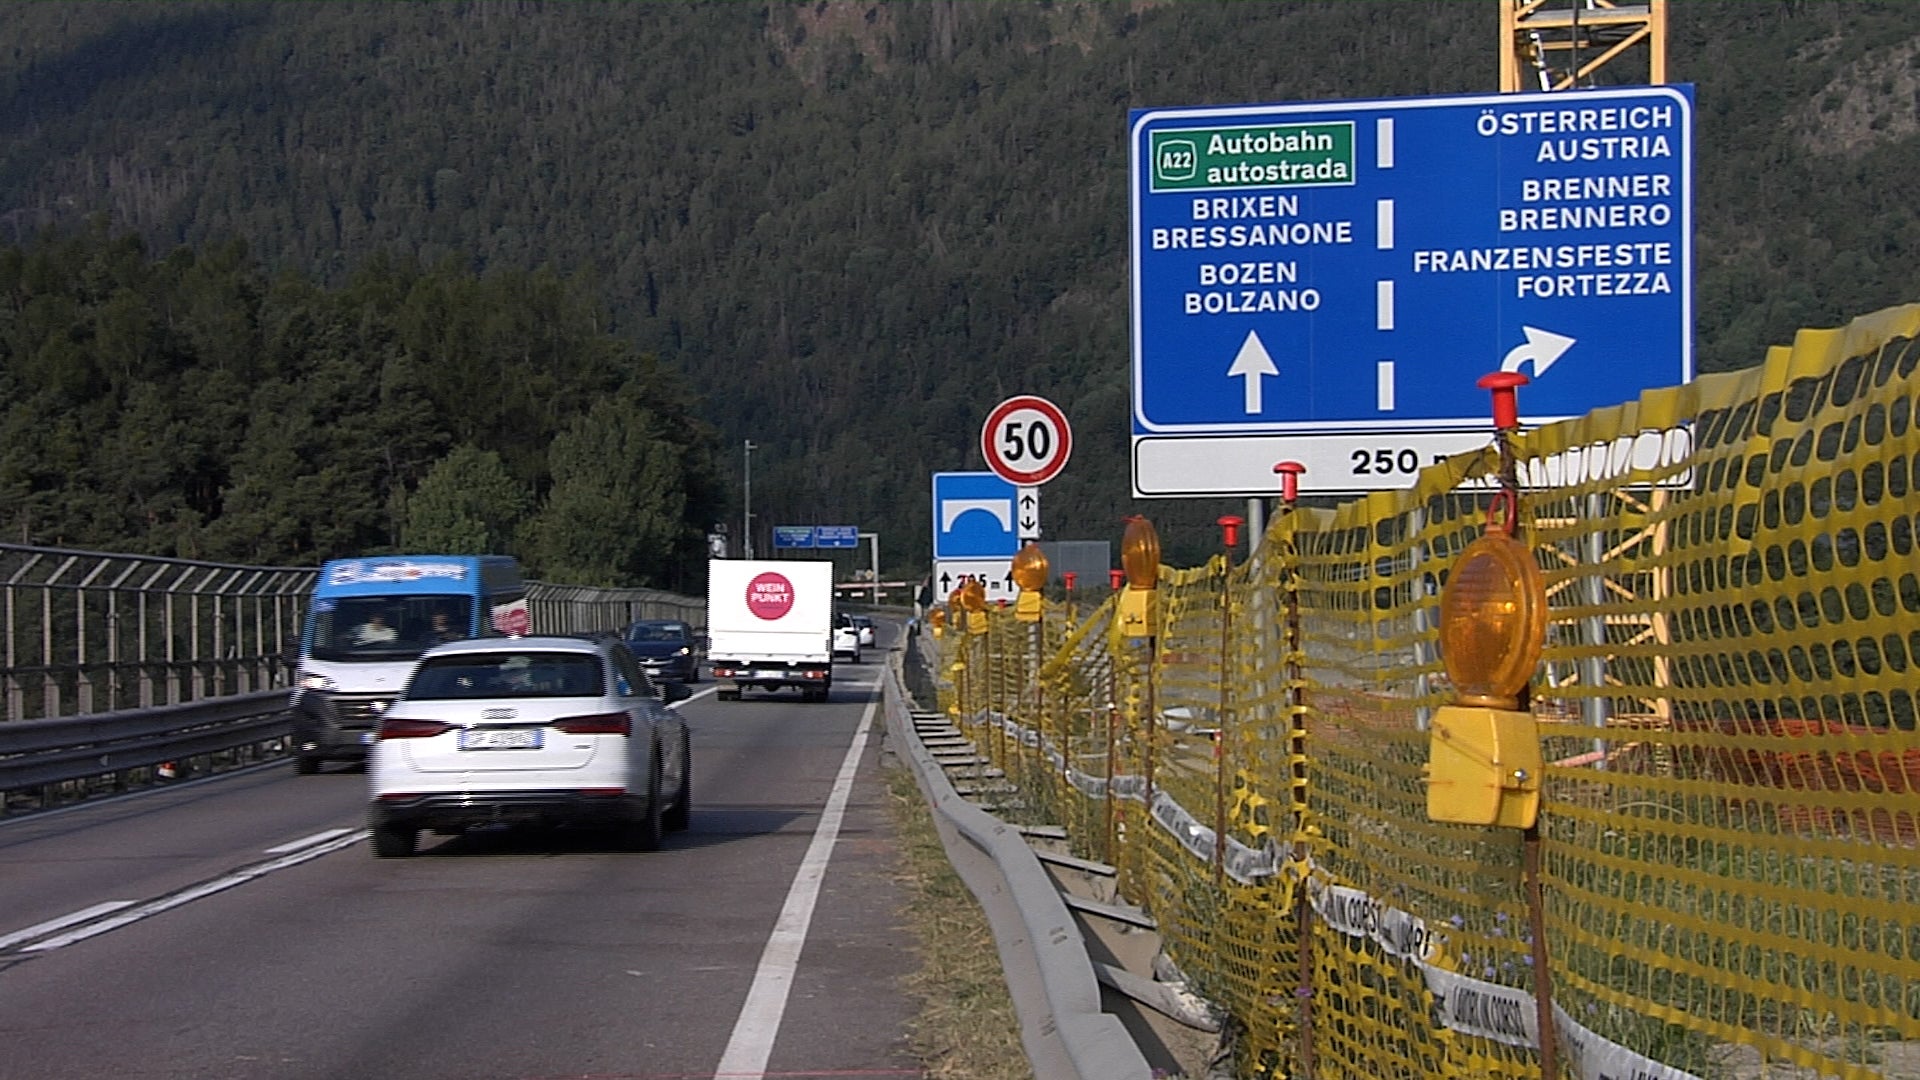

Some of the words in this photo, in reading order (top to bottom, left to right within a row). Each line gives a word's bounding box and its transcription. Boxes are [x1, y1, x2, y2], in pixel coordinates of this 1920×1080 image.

[1477, 105, 1673, 136] ÖSTERREICH
[1207, 130, 1333, 155] Autobahn
[1537, 135, 1672, 162] AUSTRIA
[1162, 152, 1192, 169] A22
[1207, 158, 1348, 184] autostrada
[1523, 174, 1671, 202] BRENNER
[1192, 195, 1299, 220] BRIXEN
[1500, 203, 1672, 231] BRENNERO
[1152, 221, 1353, 250] BRESSANONE
[1414, 242, 1672, 272] FRANZENSFESTE
[1200, 261, 1297, 285] BOZEN
[1517, 272, 1672, 298] FORTEZZA
[1185, 289, 1320, 314] BOLZANO
[1003, 420, 1050, 462] 50
[1351, 448, 1419, 475] 250
[750, 592, 790, 603] PUNKT
[754, 582, 786, 593] WEIN
